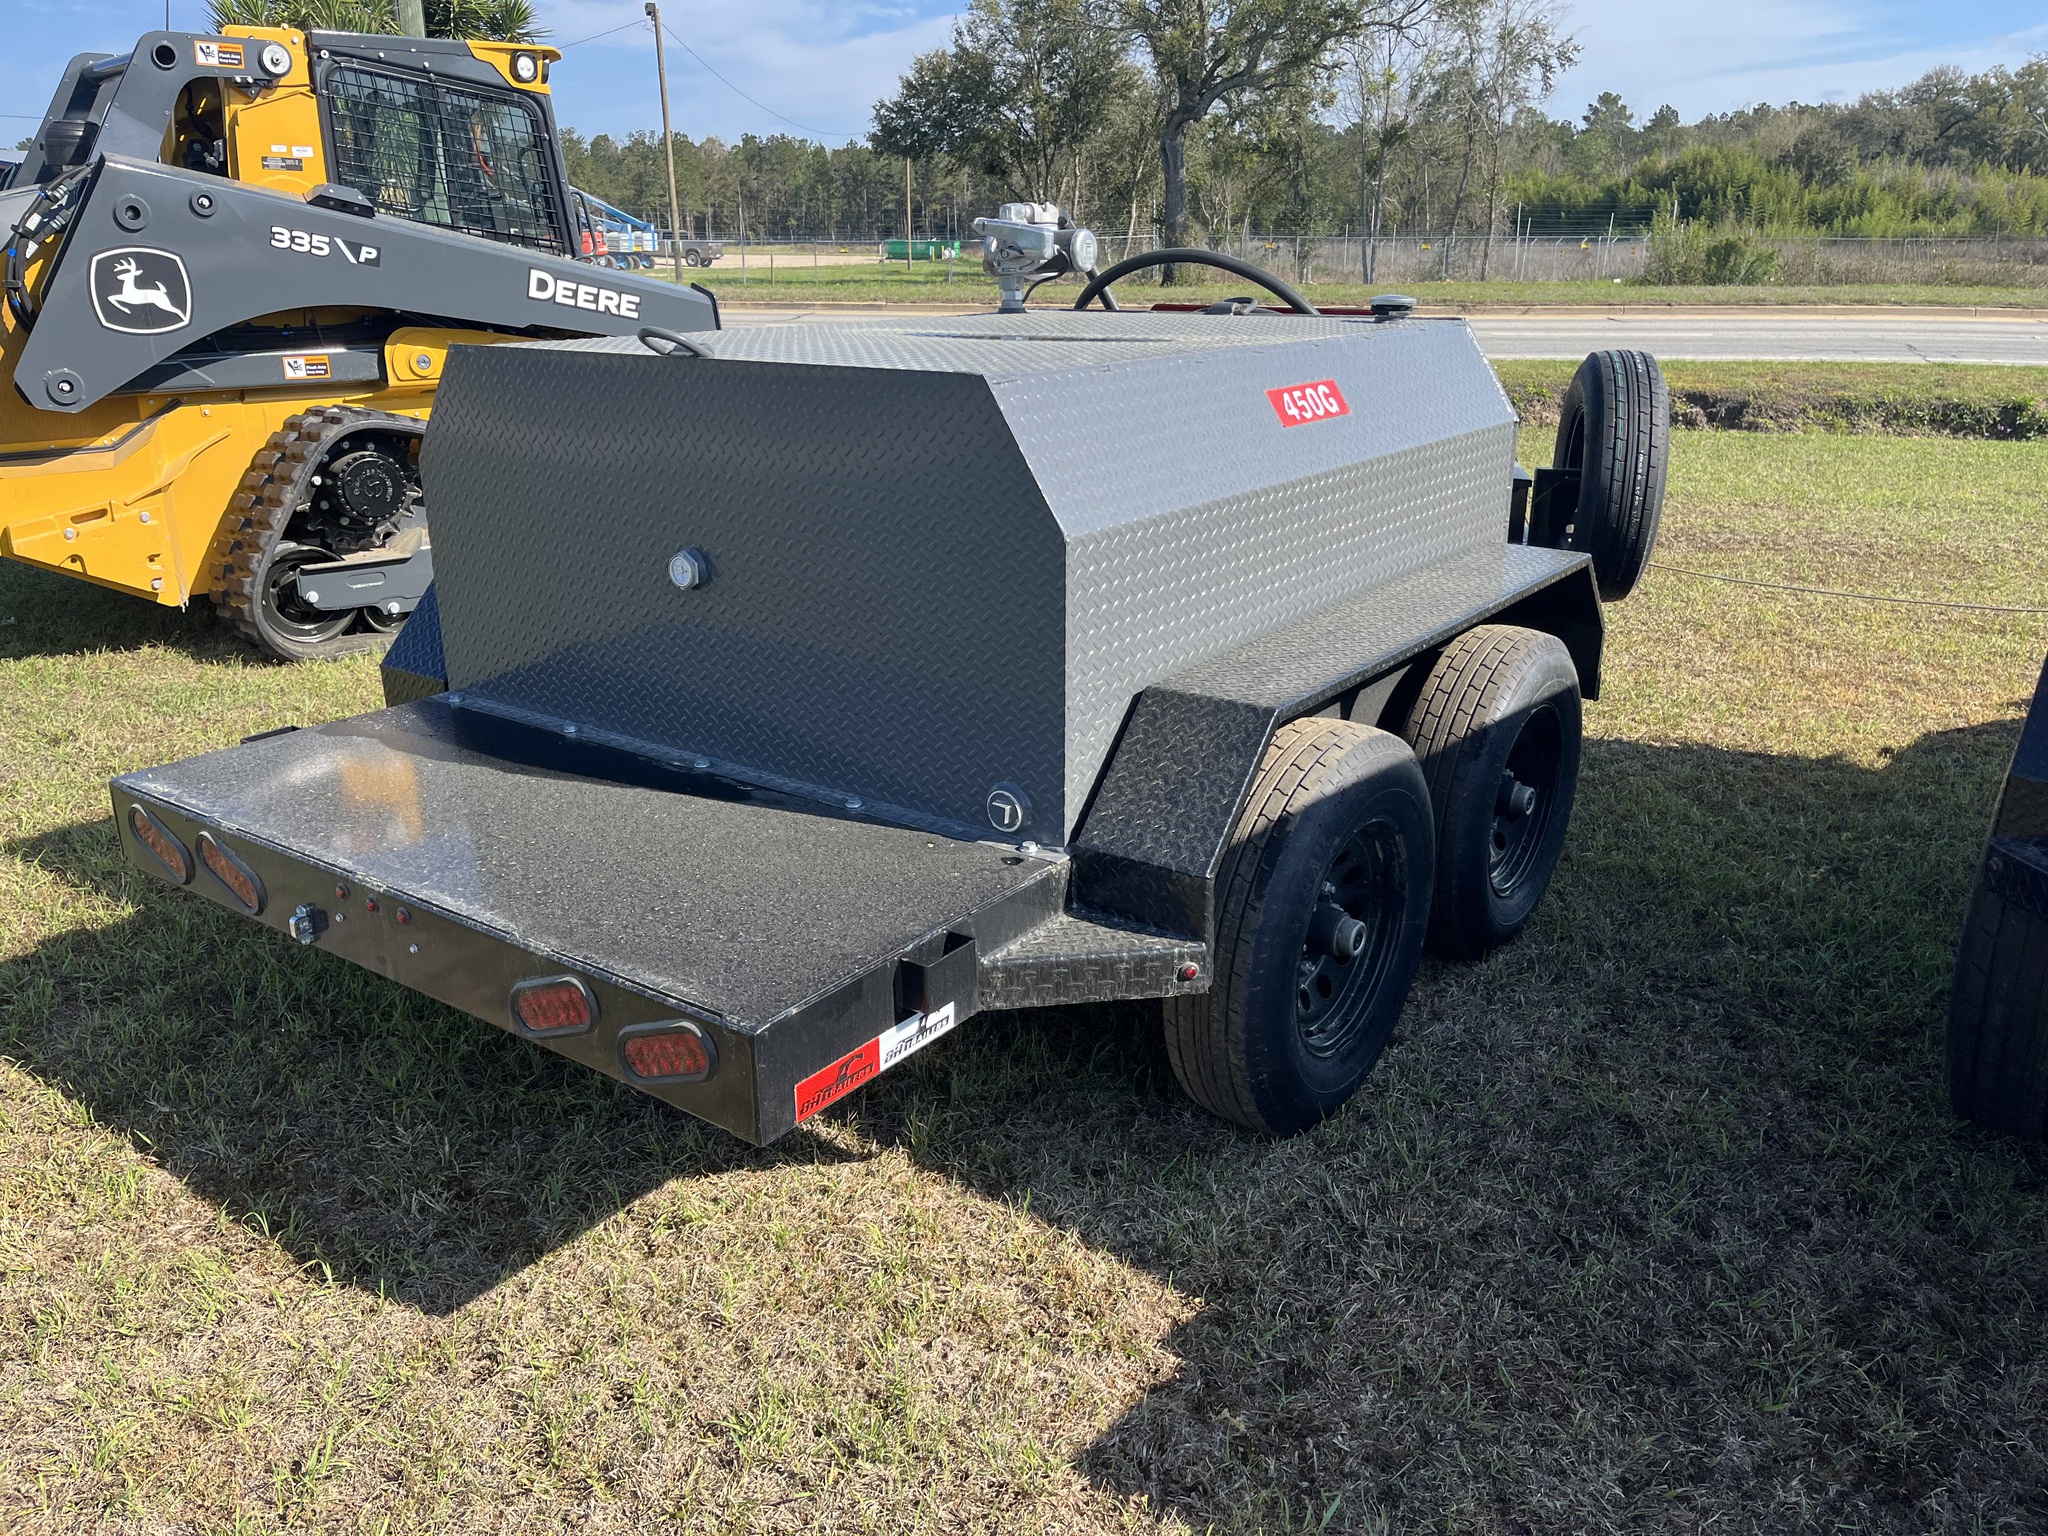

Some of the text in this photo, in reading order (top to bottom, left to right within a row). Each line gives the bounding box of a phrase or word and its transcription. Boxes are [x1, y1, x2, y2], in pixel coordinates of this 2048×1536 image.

[269, 226, 331, 257] 335
[528, 268, 640, 319] DEERE
[1282, 384, 1340, 420] 450G
